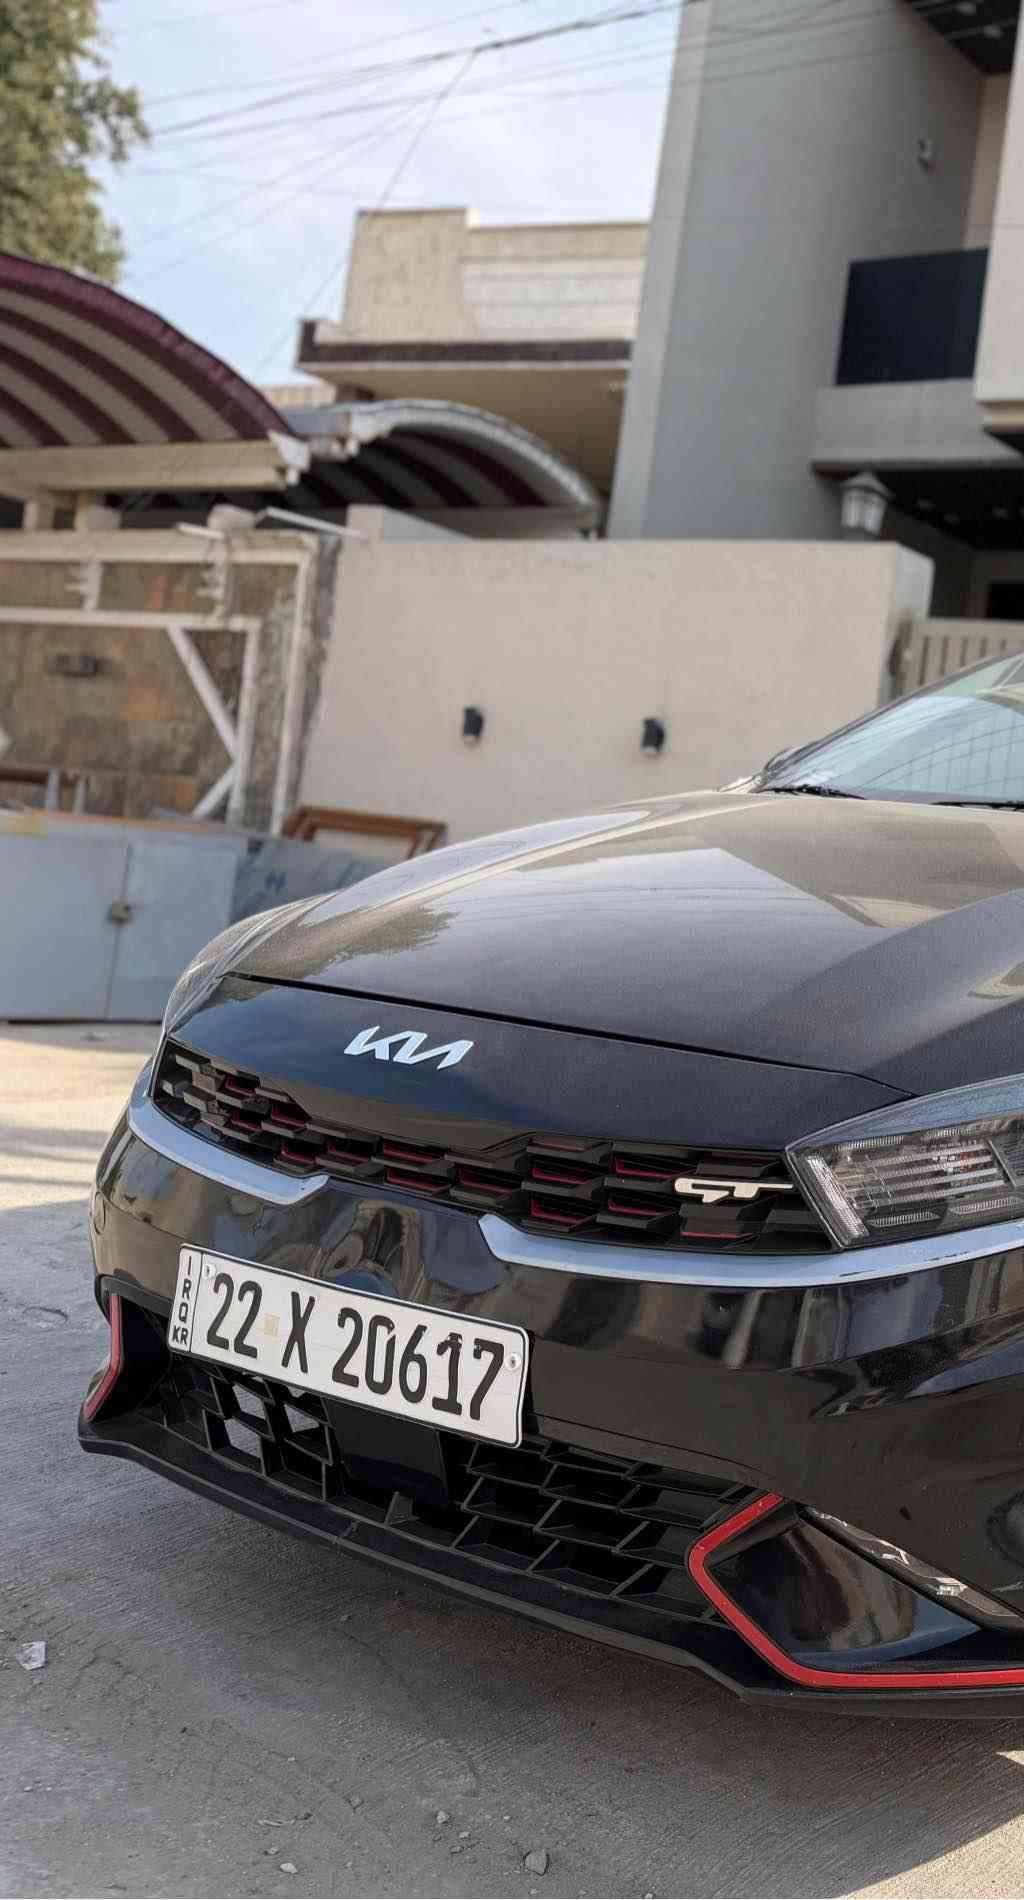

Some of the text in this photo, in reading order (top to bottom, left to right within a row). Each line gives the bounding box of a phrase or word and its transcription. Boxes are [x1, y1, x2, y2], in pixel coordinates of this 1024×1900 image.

[344, 1026, 474, 1069] KIA
[674, 1178, 794, 1203] GT
[172, 1325, 189, 1345] KR
[206, 1272, 505, 1420] 22 X 20617
